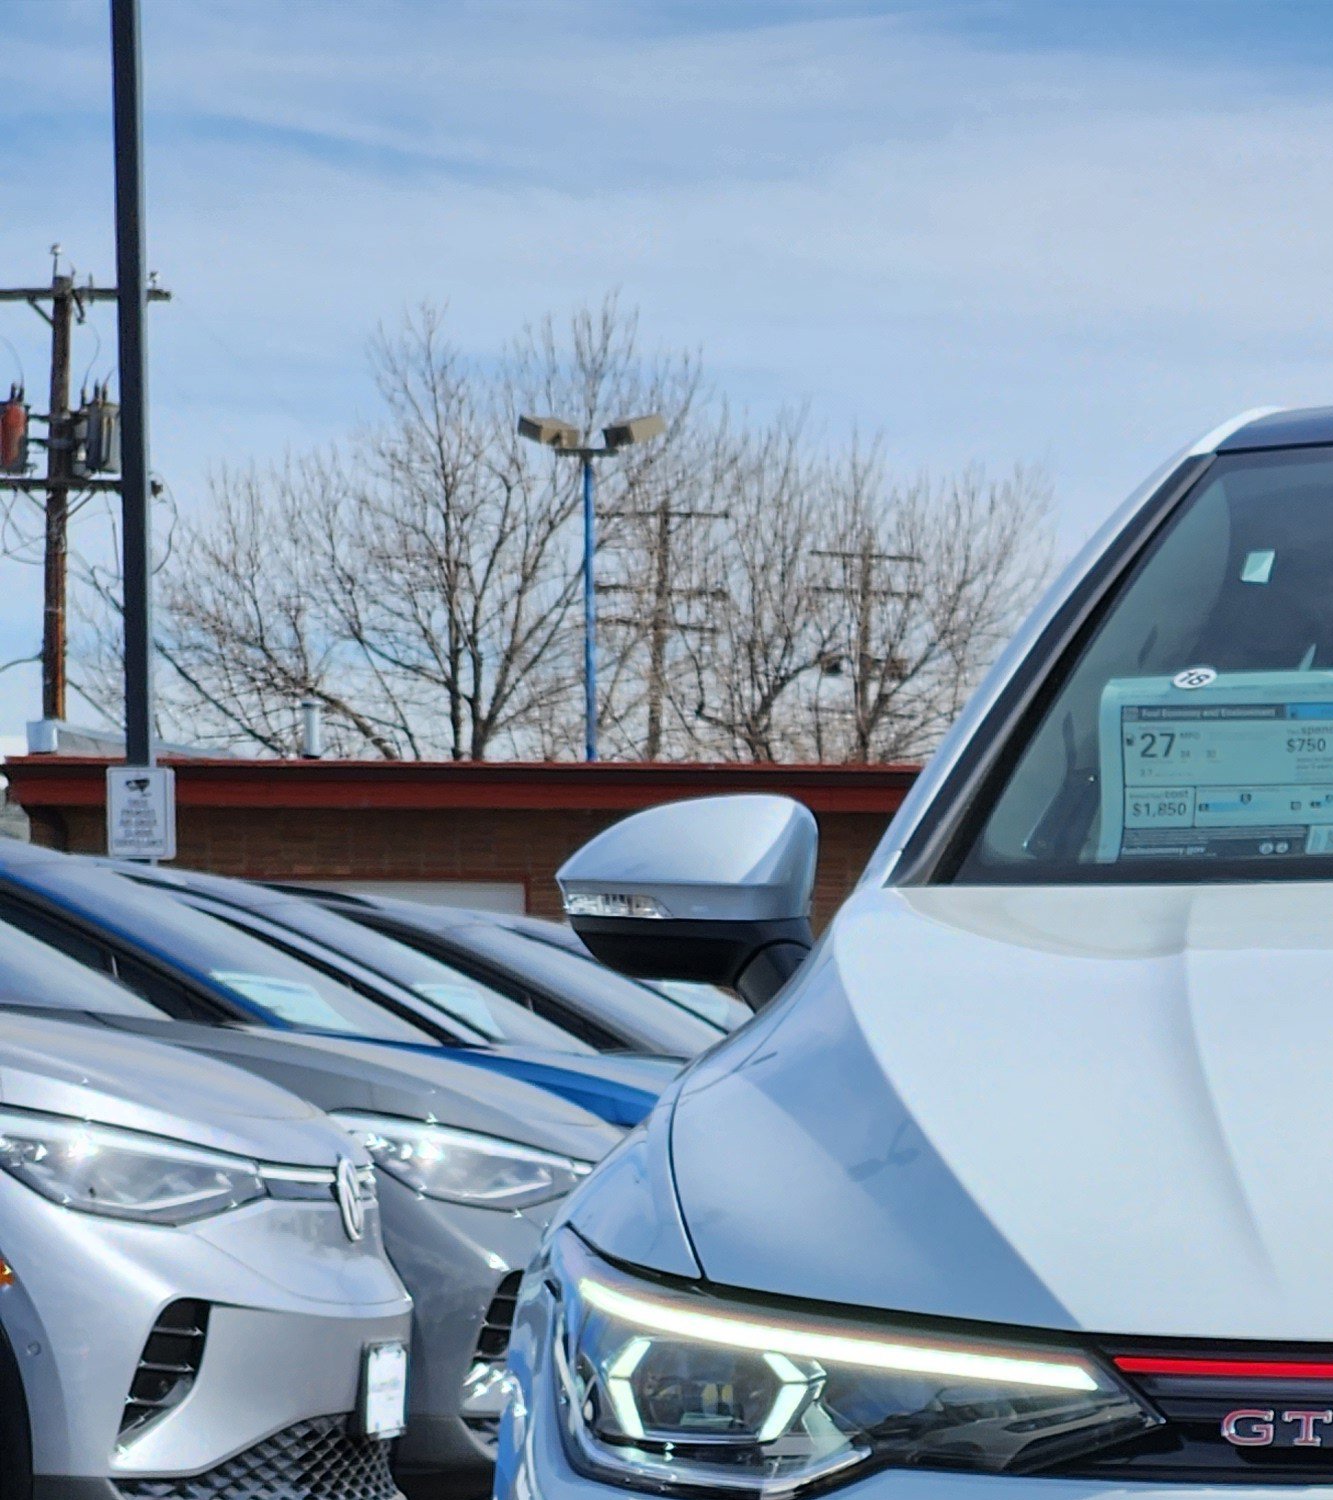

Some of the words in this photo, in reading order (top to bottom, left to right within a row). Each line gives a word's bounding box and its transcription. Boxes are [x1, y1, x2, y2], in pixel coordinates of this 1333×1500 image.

[1140, 732, 1176, 758] 27
[1286, 738, 1326, 753] $750
[1132, 802, 1187, 818] $1,850
